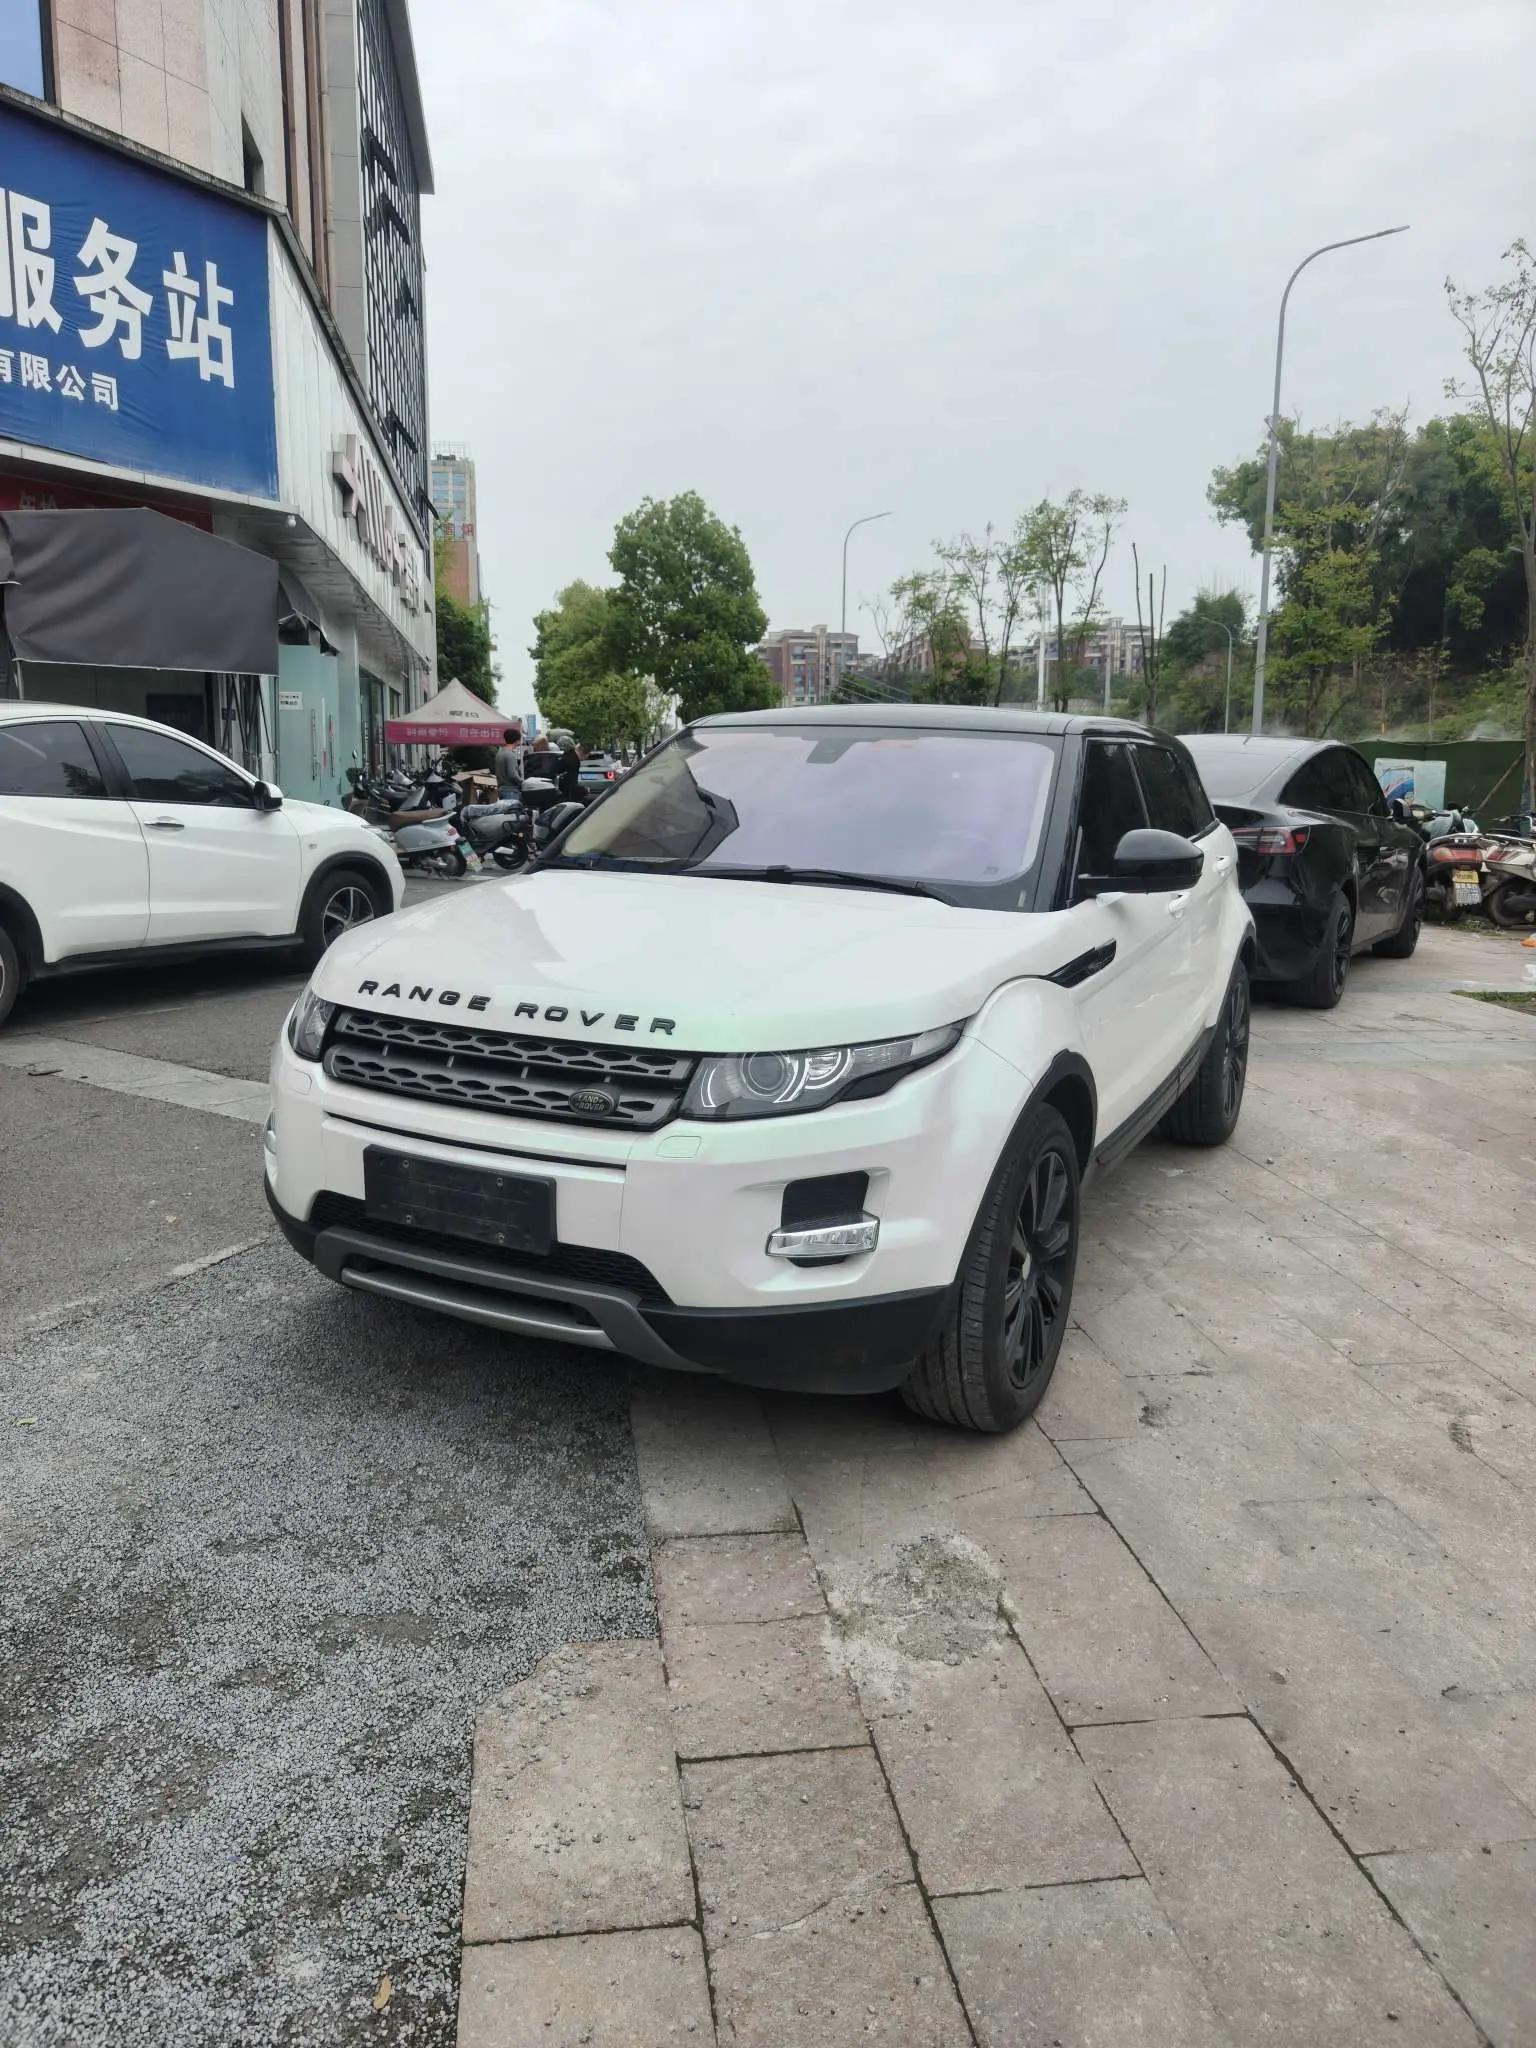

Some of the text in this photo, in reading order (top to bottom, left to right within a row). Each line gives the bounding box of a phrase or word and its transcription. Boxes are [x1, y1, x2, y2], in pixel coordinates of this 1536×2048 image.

[0, 188, 235, 389] 服务站
[357, 979, 677, 1036] RANGE ROVER
[578, 1094, 599, 1103] LAND
[579, 1102, 605, 1111] ROVER
